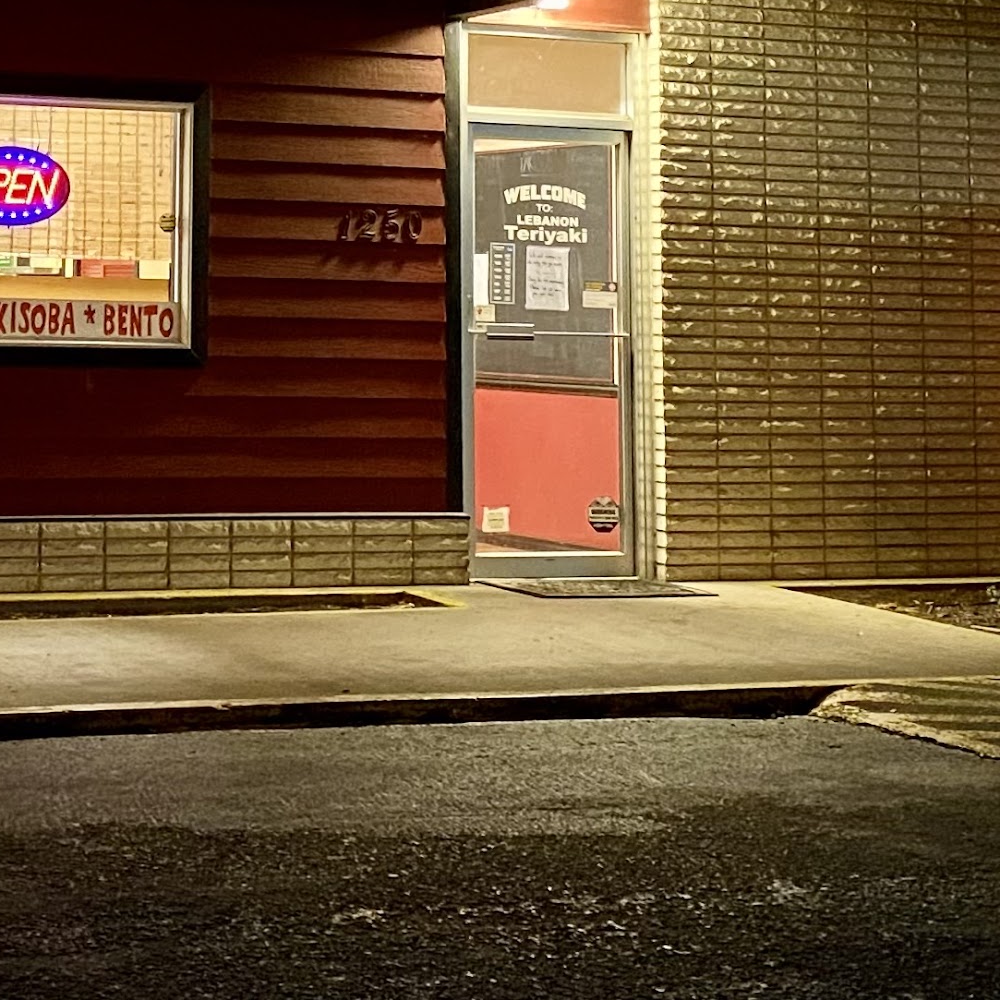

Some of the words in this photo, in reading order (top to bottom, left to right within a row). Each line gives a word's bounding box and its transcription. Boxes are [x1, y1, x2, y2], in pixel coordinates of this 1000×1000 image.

[503, 184, 587, 210] WELCOME
[339, 208, 422, 240] 1250
[516, 214, 579, 228] LEBANON
[503, 225, 588, 245] Teriyaki
[103, 303, 174, 338] BENTO
